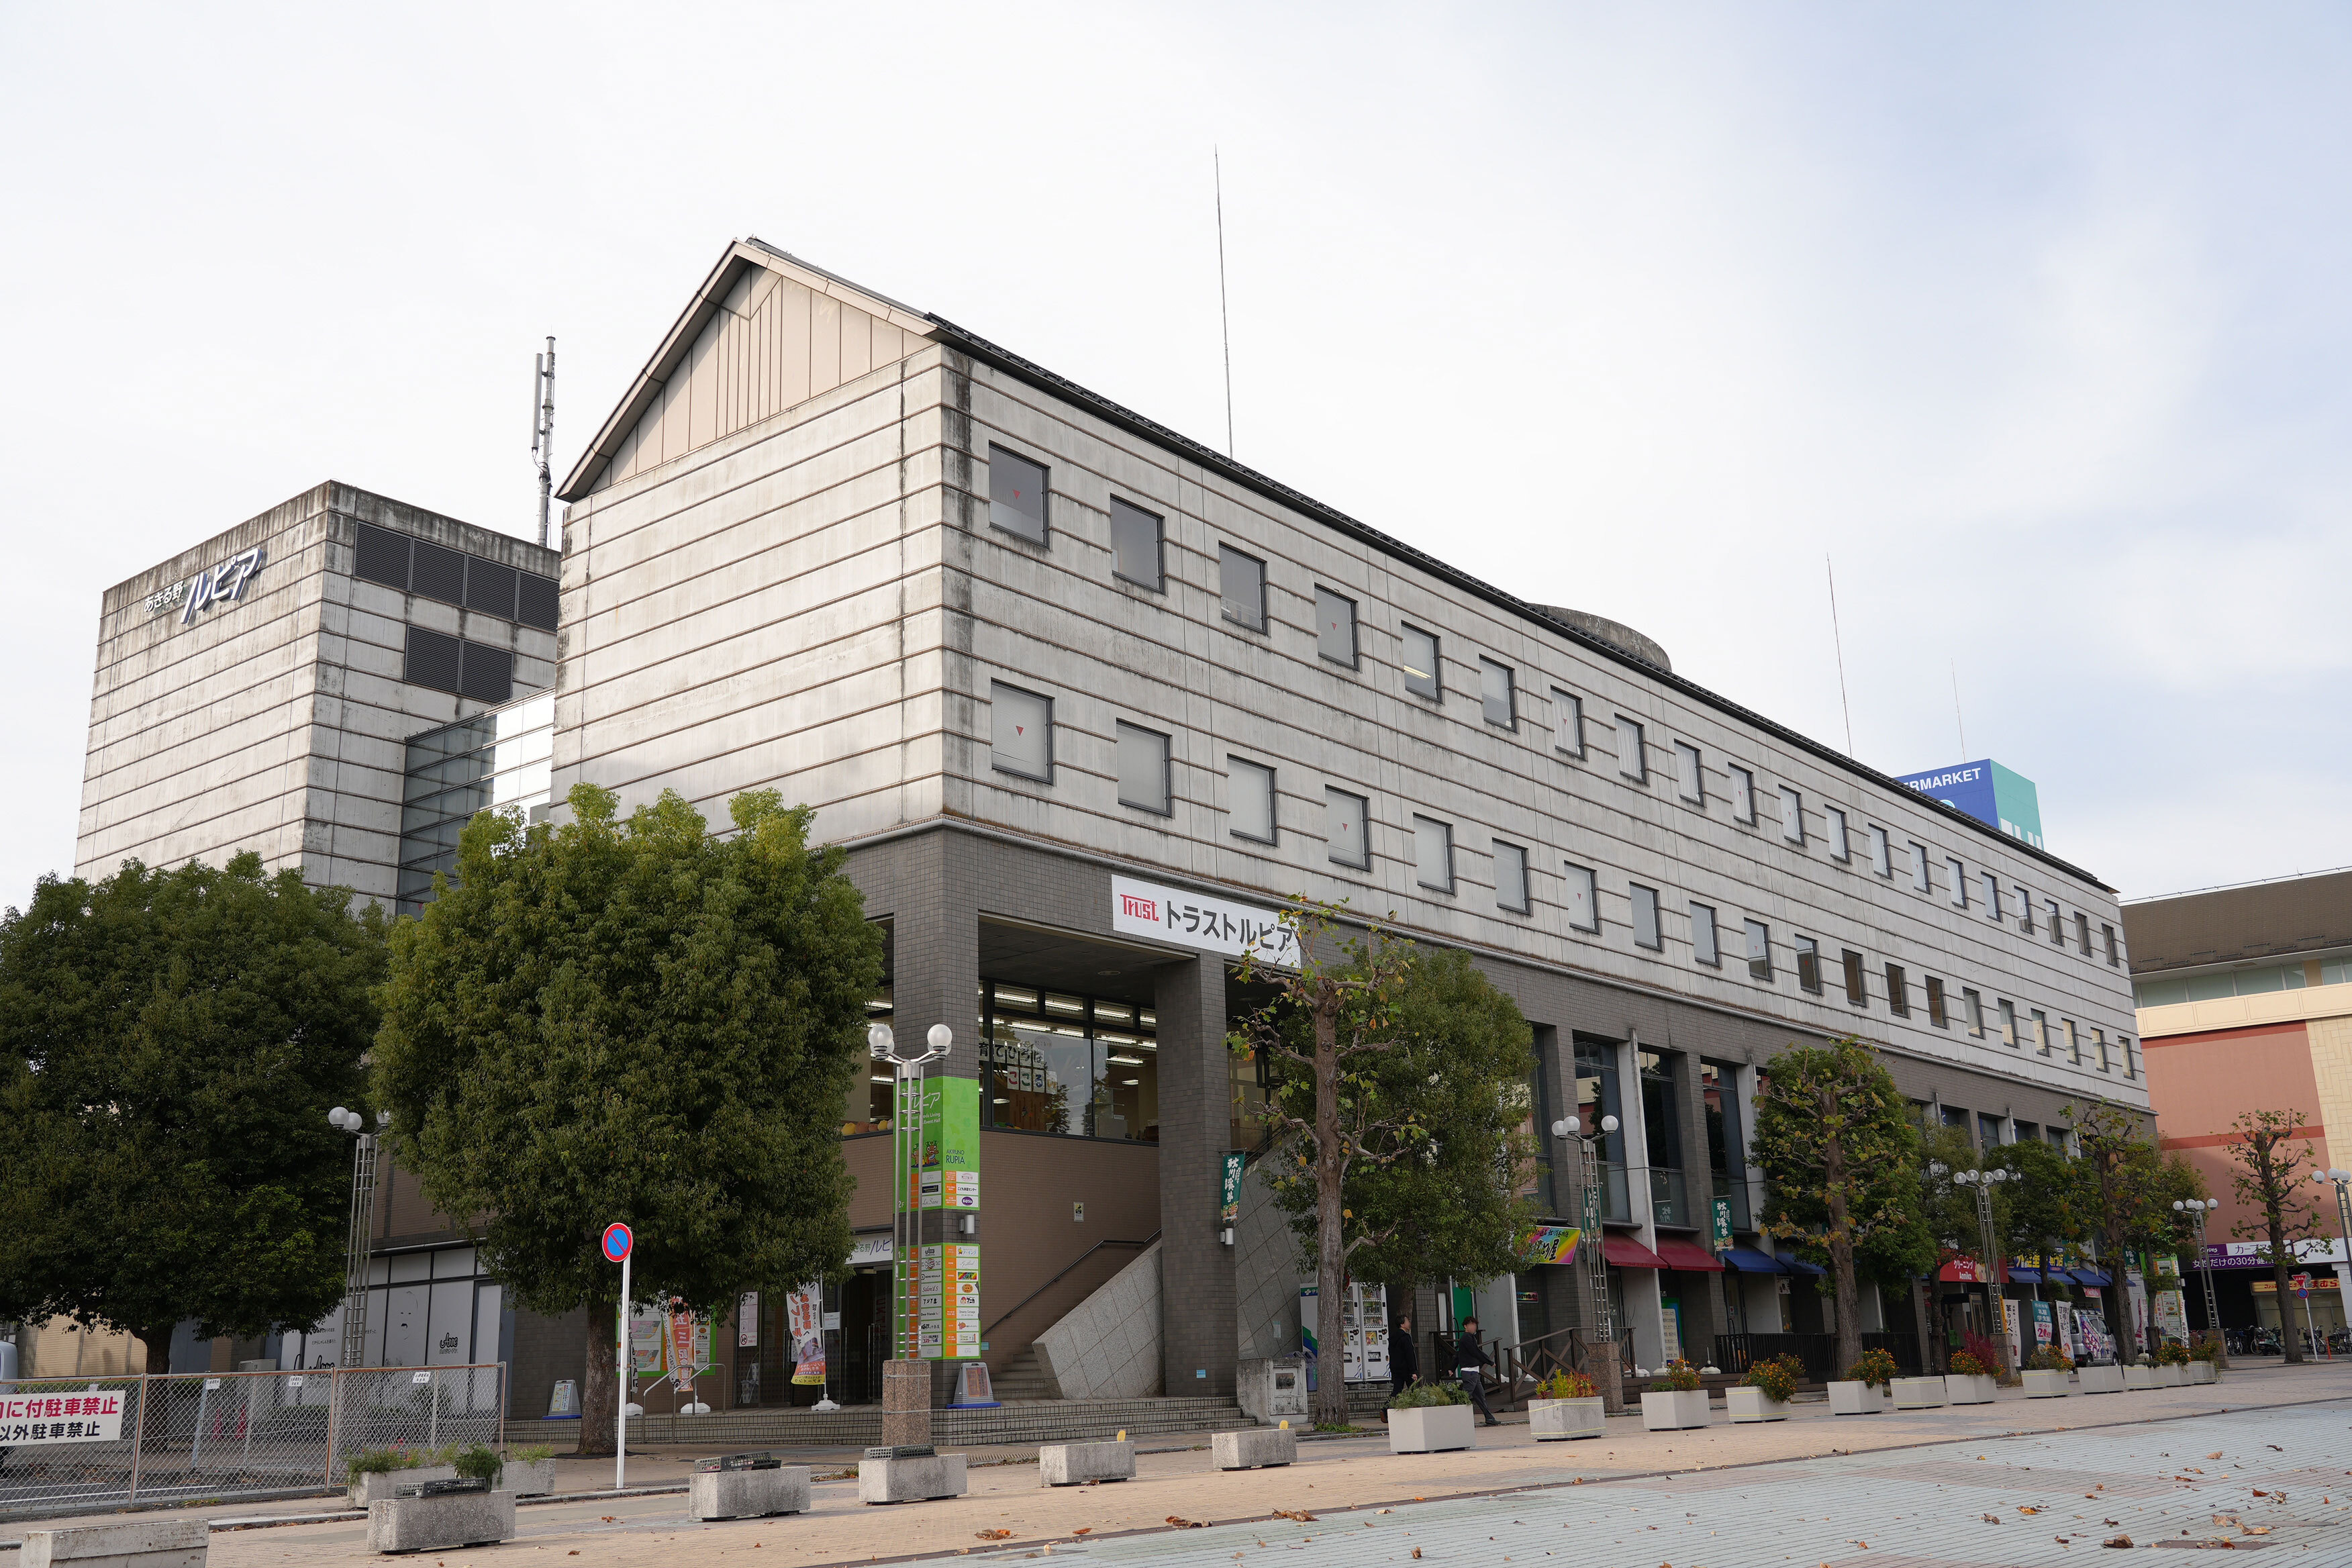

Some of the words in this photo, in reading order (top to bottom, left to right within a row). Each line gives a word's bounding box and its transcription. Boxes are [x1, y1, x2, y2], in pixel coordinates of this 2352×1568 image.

[180, 548, 262, 624] ルピア
[144, 581, 184, 612] あきる野
[1167, 900, 1293, 952] トラストルピア
[946, 1155, 965, 1164] RUPIA
[854, 1243, 871, 1253] きる野
[869, 1238, 893, 1256] ルピ
[1953, 1259, 1973, 1270] クリーニング
[2310, 1279, 2337, 1288] まむら
[0, 1396, 118, 1418] に付駐車禁止
